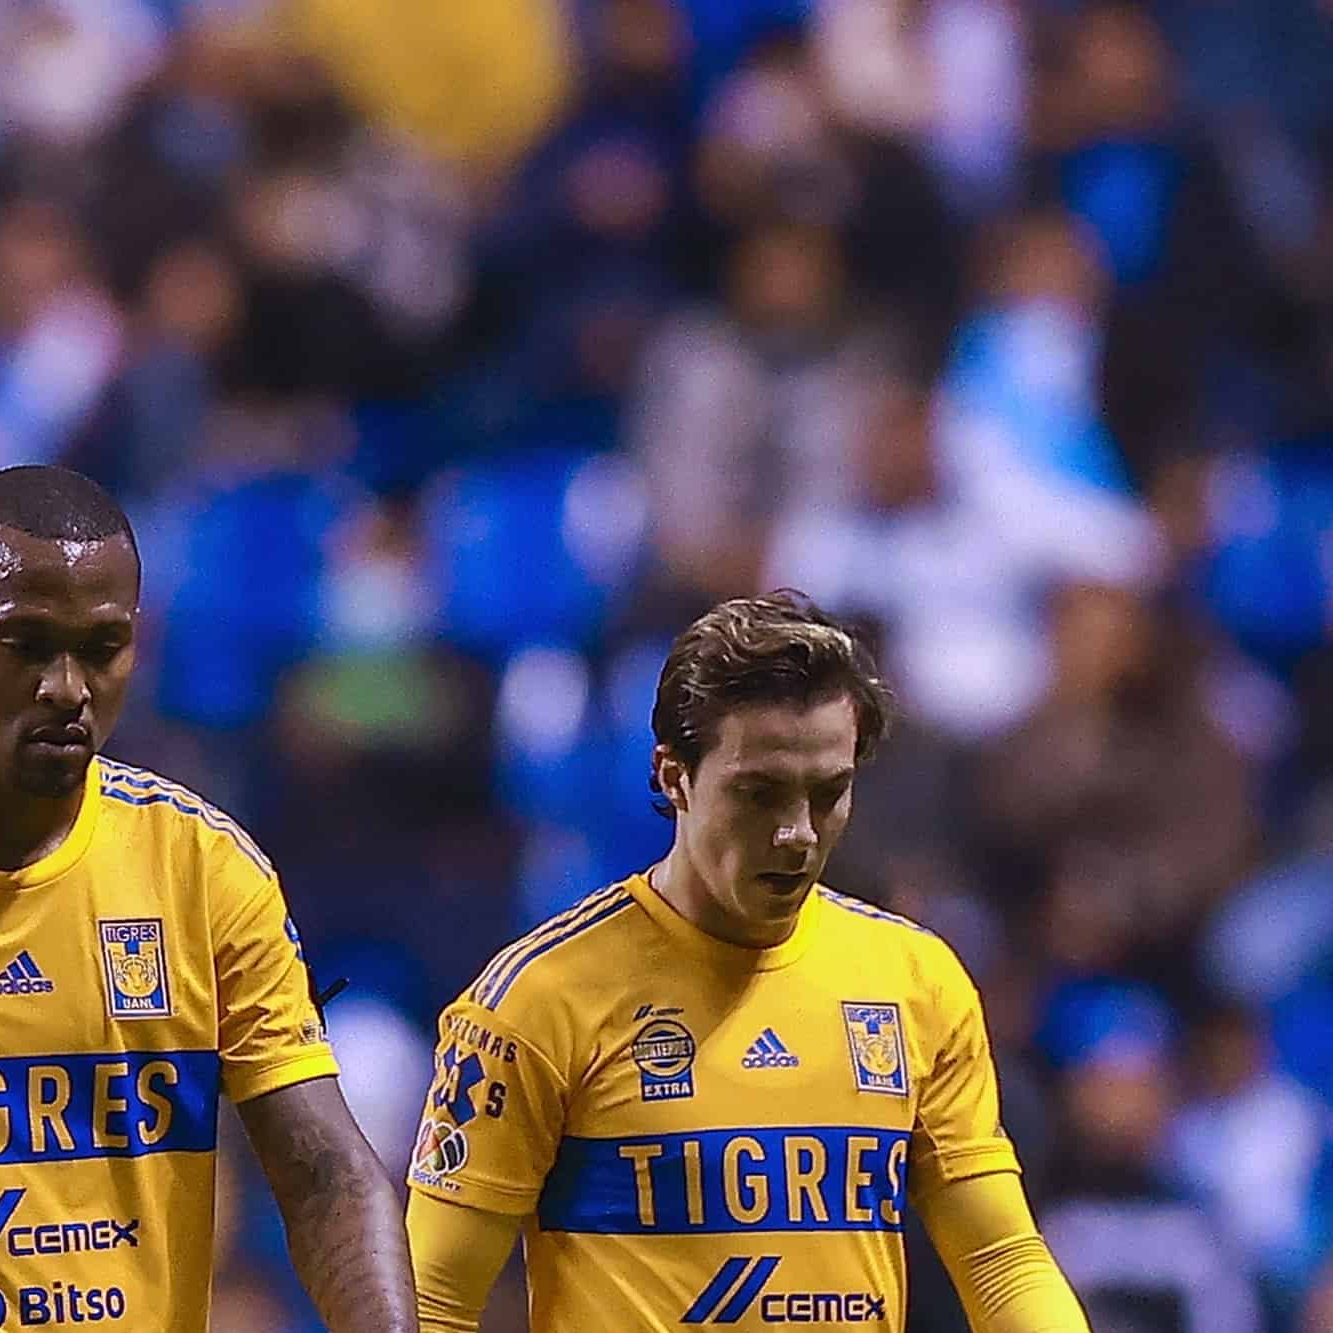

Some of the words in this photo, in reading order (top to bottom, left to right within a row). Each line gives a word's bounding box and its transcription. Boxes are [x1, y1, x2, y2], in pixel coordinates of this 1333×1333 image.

[106, 924, 158, 943] TIGRES
[741, 1052, 800, 1069] adidas
[644, 1083, 691, 1098] EXTRA
[618, 1135, 909, 1227] TIGRES
[7, 1219, 141, 1257] CEMEX
[18, 1281, 126, 1326] Bitso
[760, 1293, 886, 1323] CEMEX
